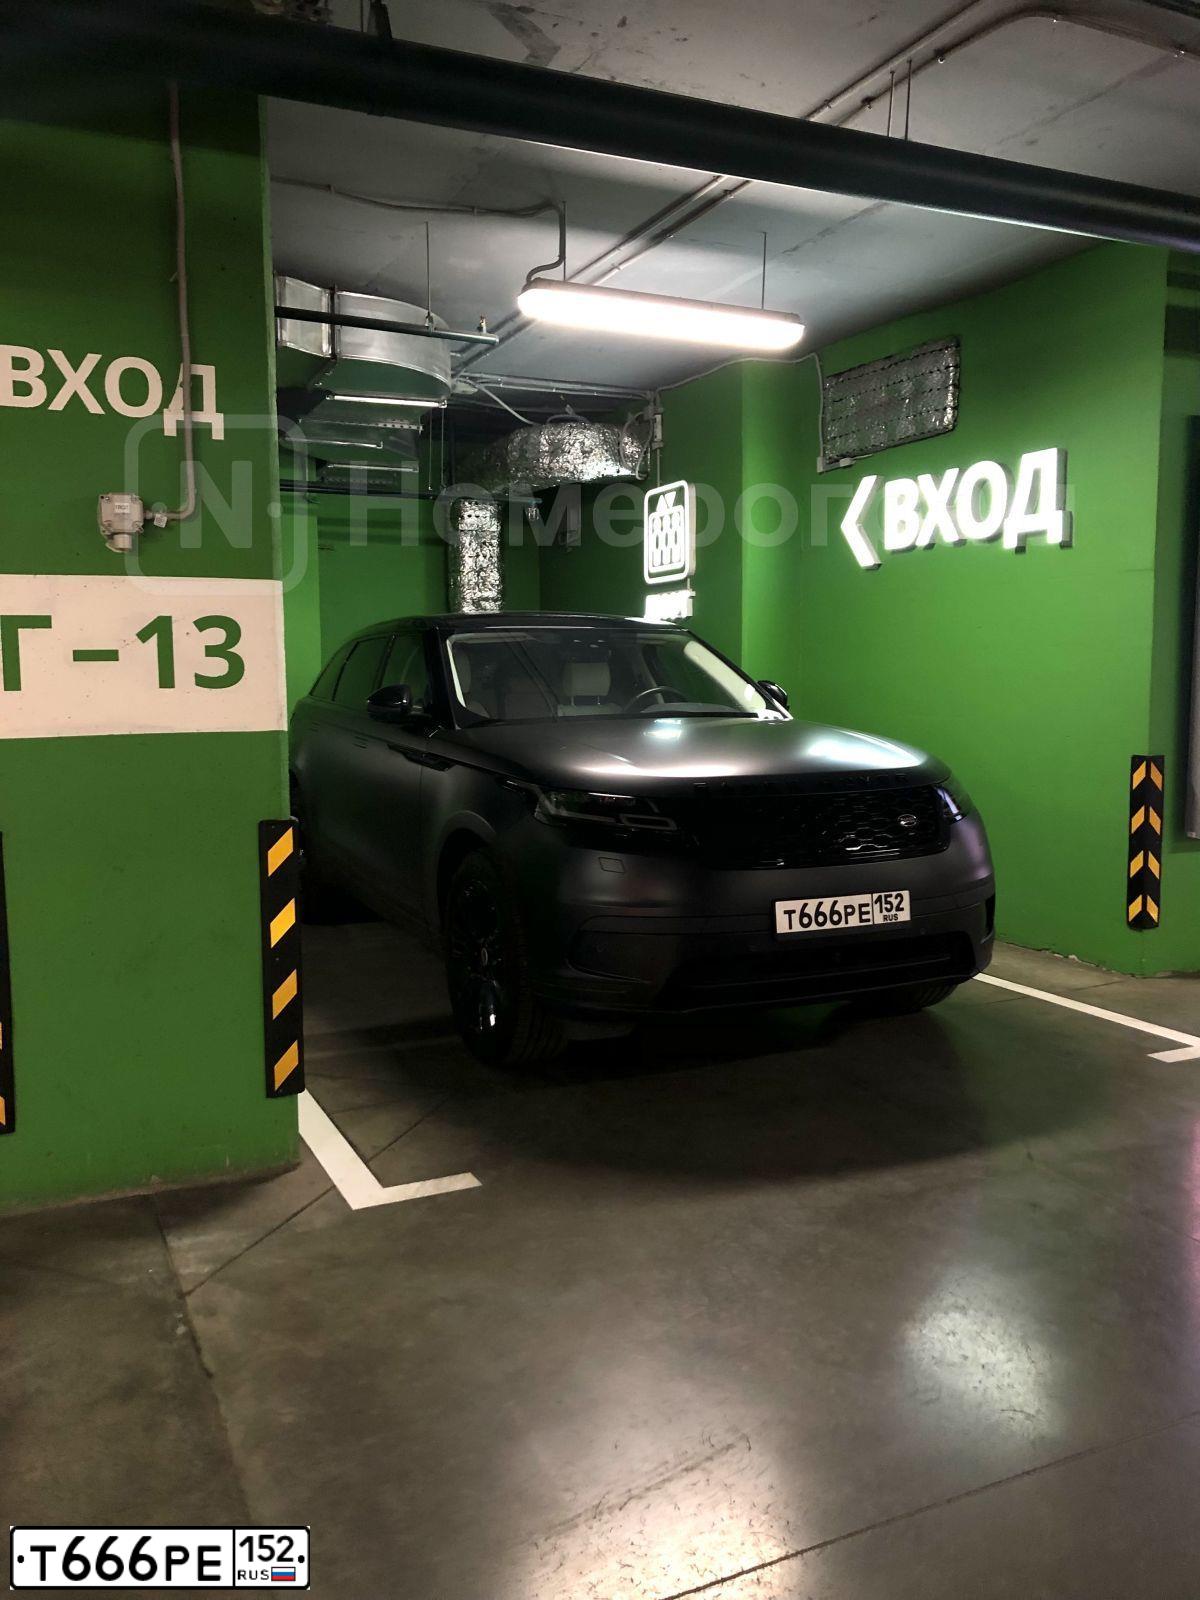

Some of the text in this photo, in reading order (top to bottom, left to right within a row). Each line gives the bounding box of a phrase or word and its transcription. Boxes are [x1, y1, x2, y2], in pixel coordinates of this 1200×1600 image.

[0, 344, 225, 440] ВХОД
[883, 447, 1071, 551] ВХОД
[783, 893, 904, 930] Т666РЕ 152
[882, 913, 899, 922] RUS
